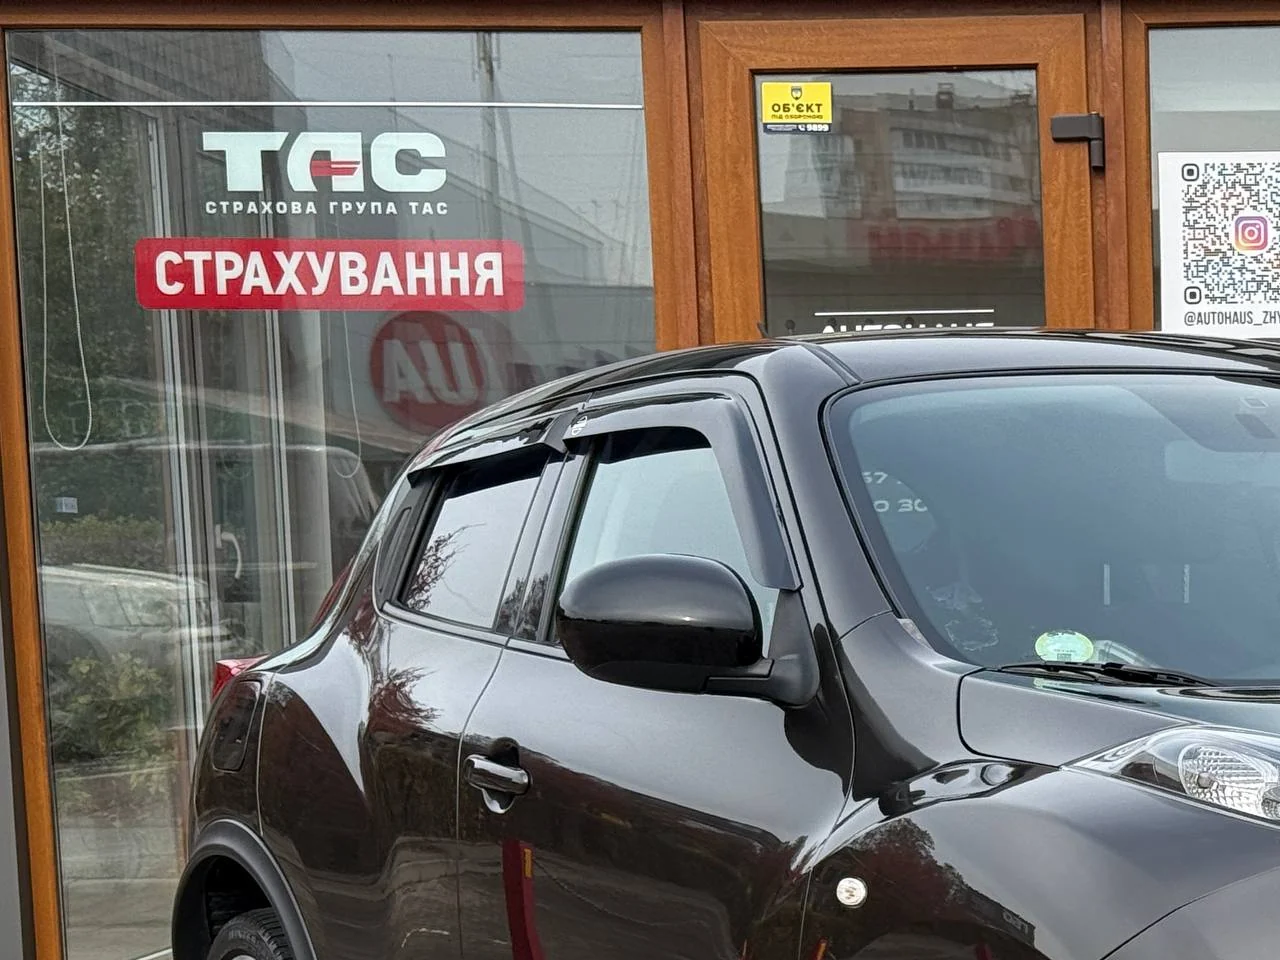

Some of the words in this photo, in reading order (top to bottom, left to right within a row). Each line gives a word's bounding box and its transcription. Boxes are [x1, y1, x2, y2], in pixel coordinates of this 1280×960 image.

[771, 103, 823, 113] ОБ'ЄКТ
[206, 201, 317, 215] СТРАХОВА
[330, 201, 397, 215] ГРУПА
[409, 201, 448, 215] ТАС
[155, 250, 504, 296] СТРАХУВАННЯ
